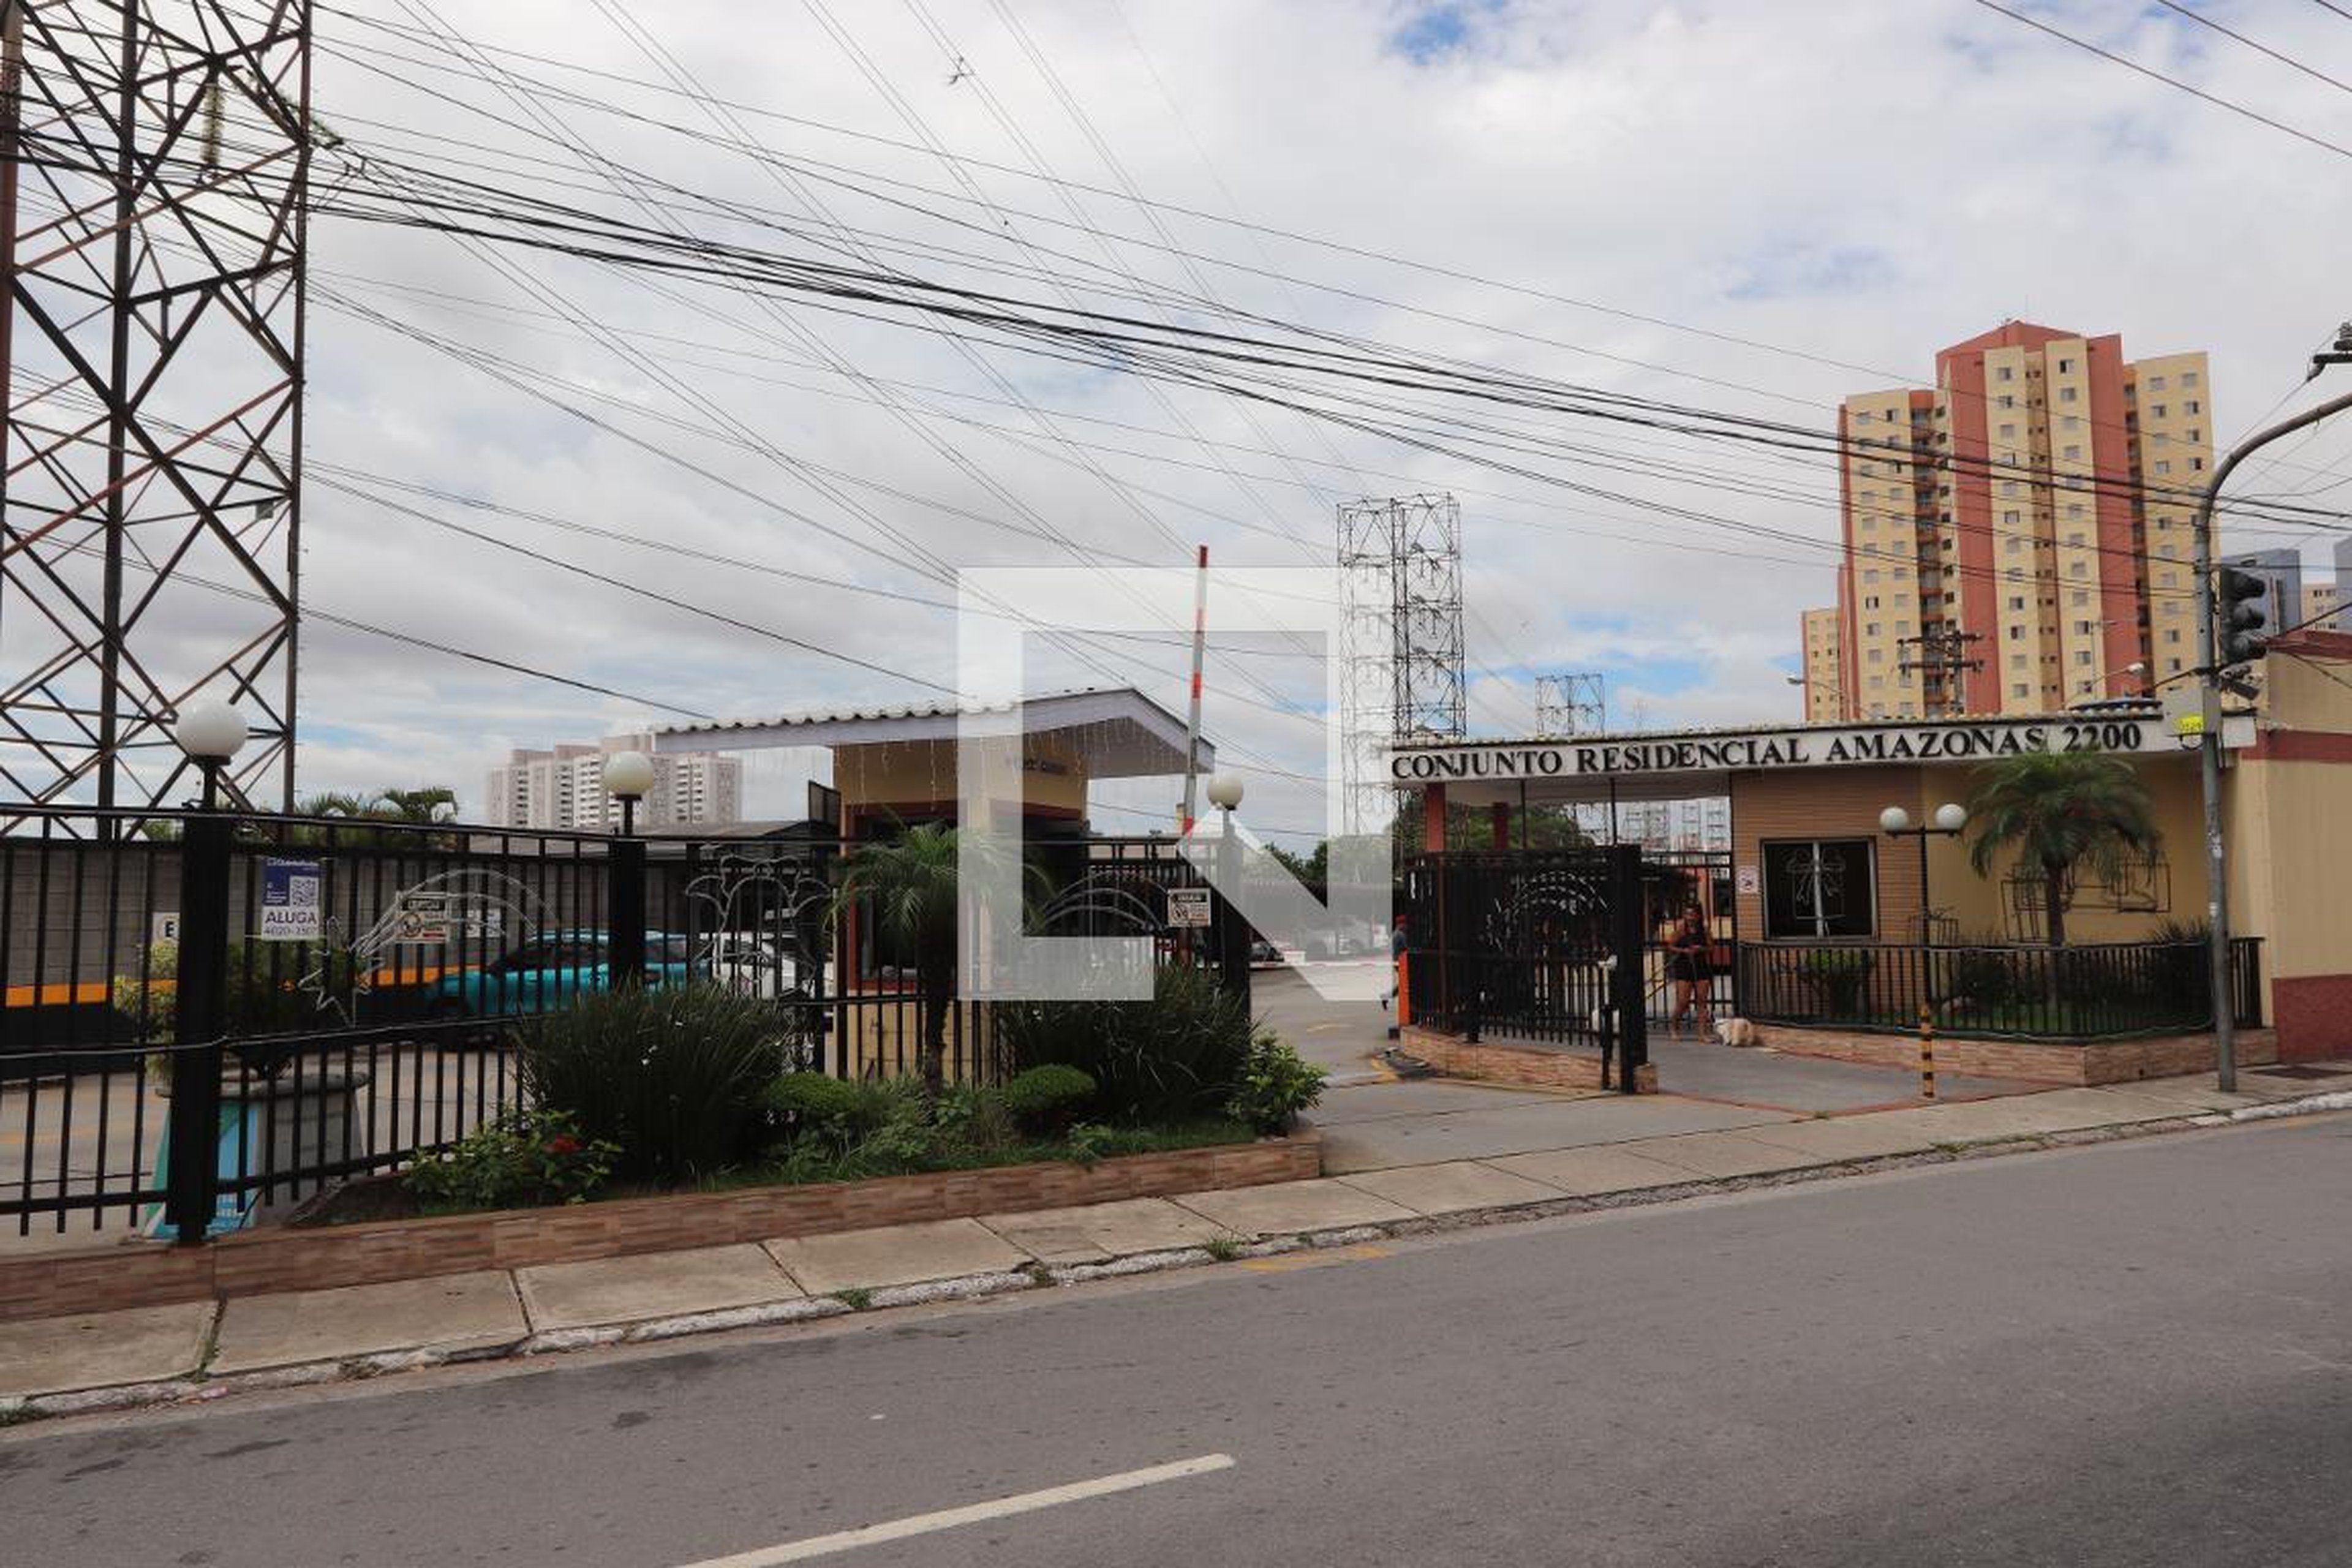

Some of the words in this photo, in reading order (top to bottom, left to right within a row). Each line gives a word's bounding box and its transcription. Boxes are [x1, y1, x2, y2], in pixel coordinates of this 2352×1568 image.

[1392, 750, 1562, 779] CONJUNTO
[1575, 739, 1810, 773] RESIDENCIAL
[1826, 726, 2045, 761] AMAZONAS
[2062, 723, 2142, 753] 2200
[265, 911, 317, 924] ALUGA
